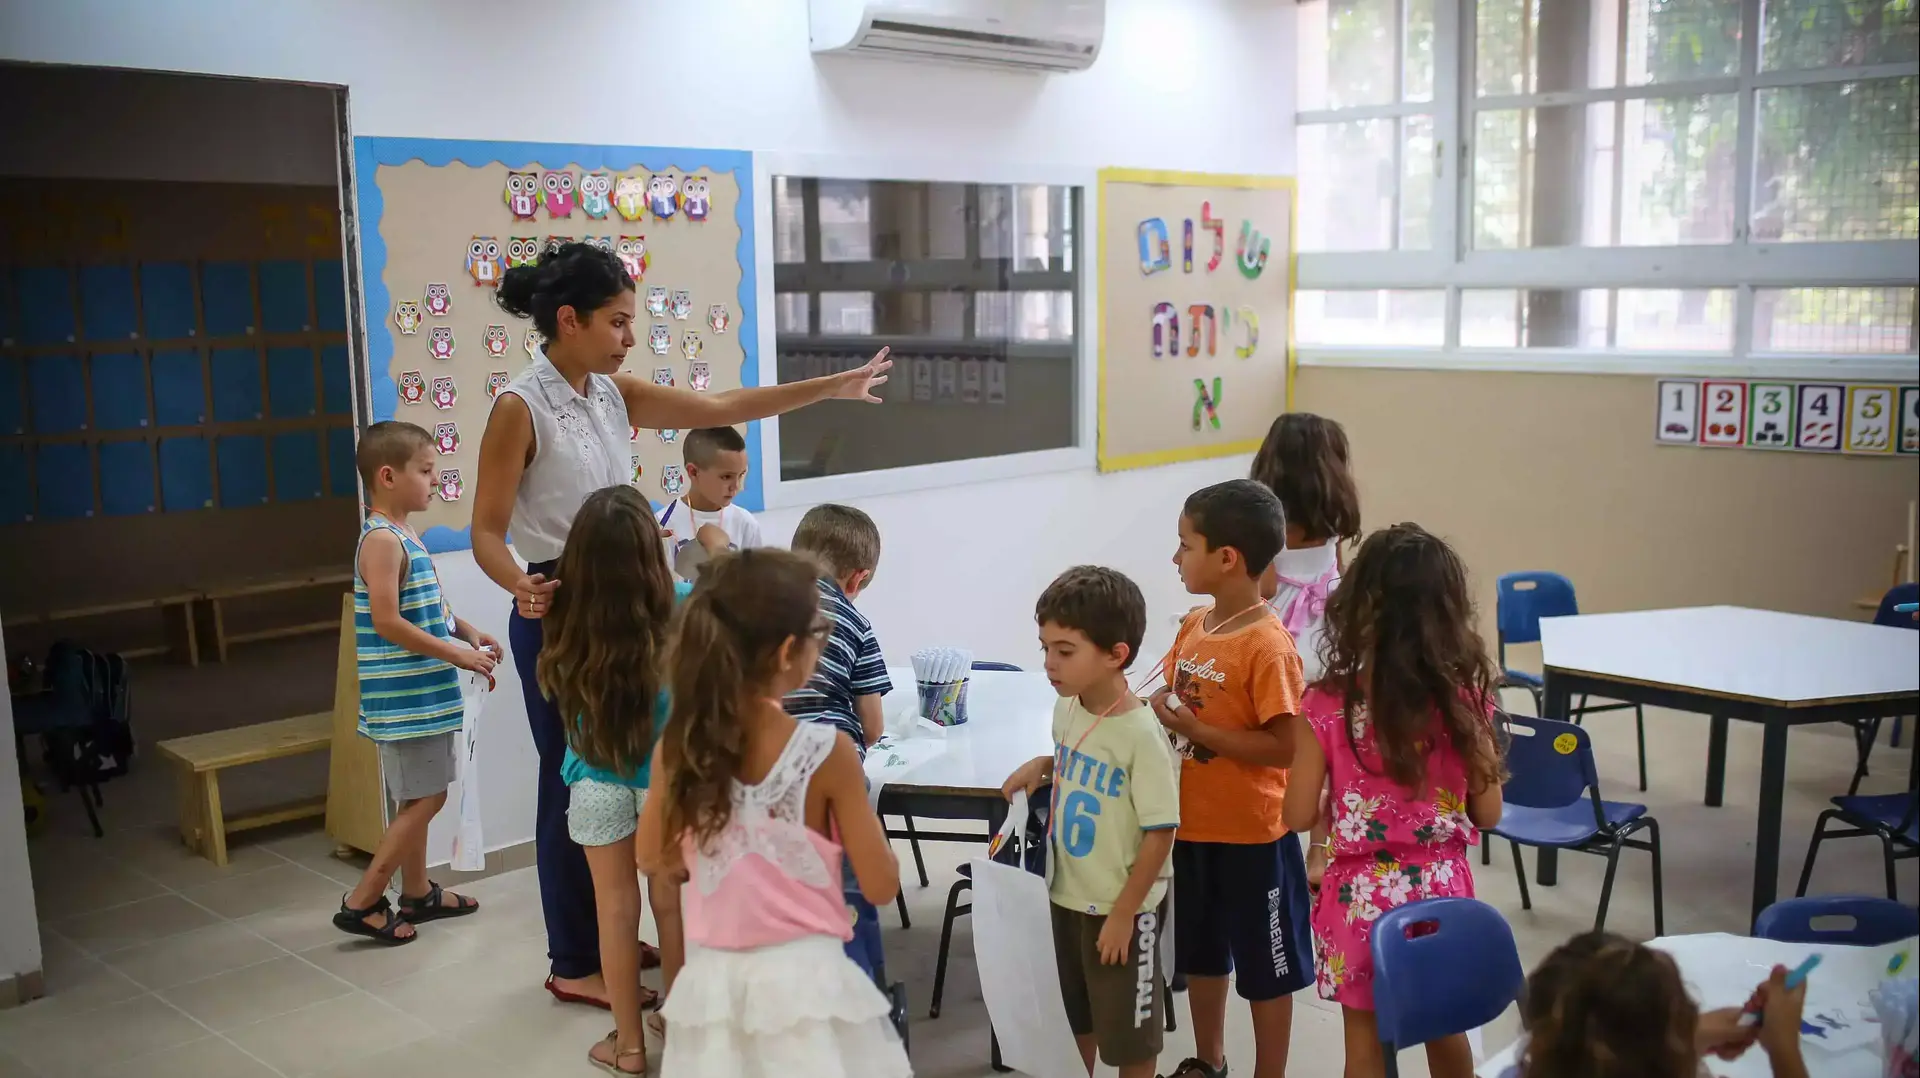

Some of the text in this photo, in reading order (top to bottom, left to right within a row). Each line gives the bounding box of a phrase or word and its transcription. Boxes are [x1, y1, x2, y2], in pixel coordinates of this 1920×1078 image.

[1138, 201, 1270, 279] שלום
[1193, 377, 1222, 430] א
[1673, 388, 1883, 419] 1 2 3 4 5
[1134, 912, 1156, 1029] OOTBALL
[1267, 887, 1289, 978] BORDERLINE
